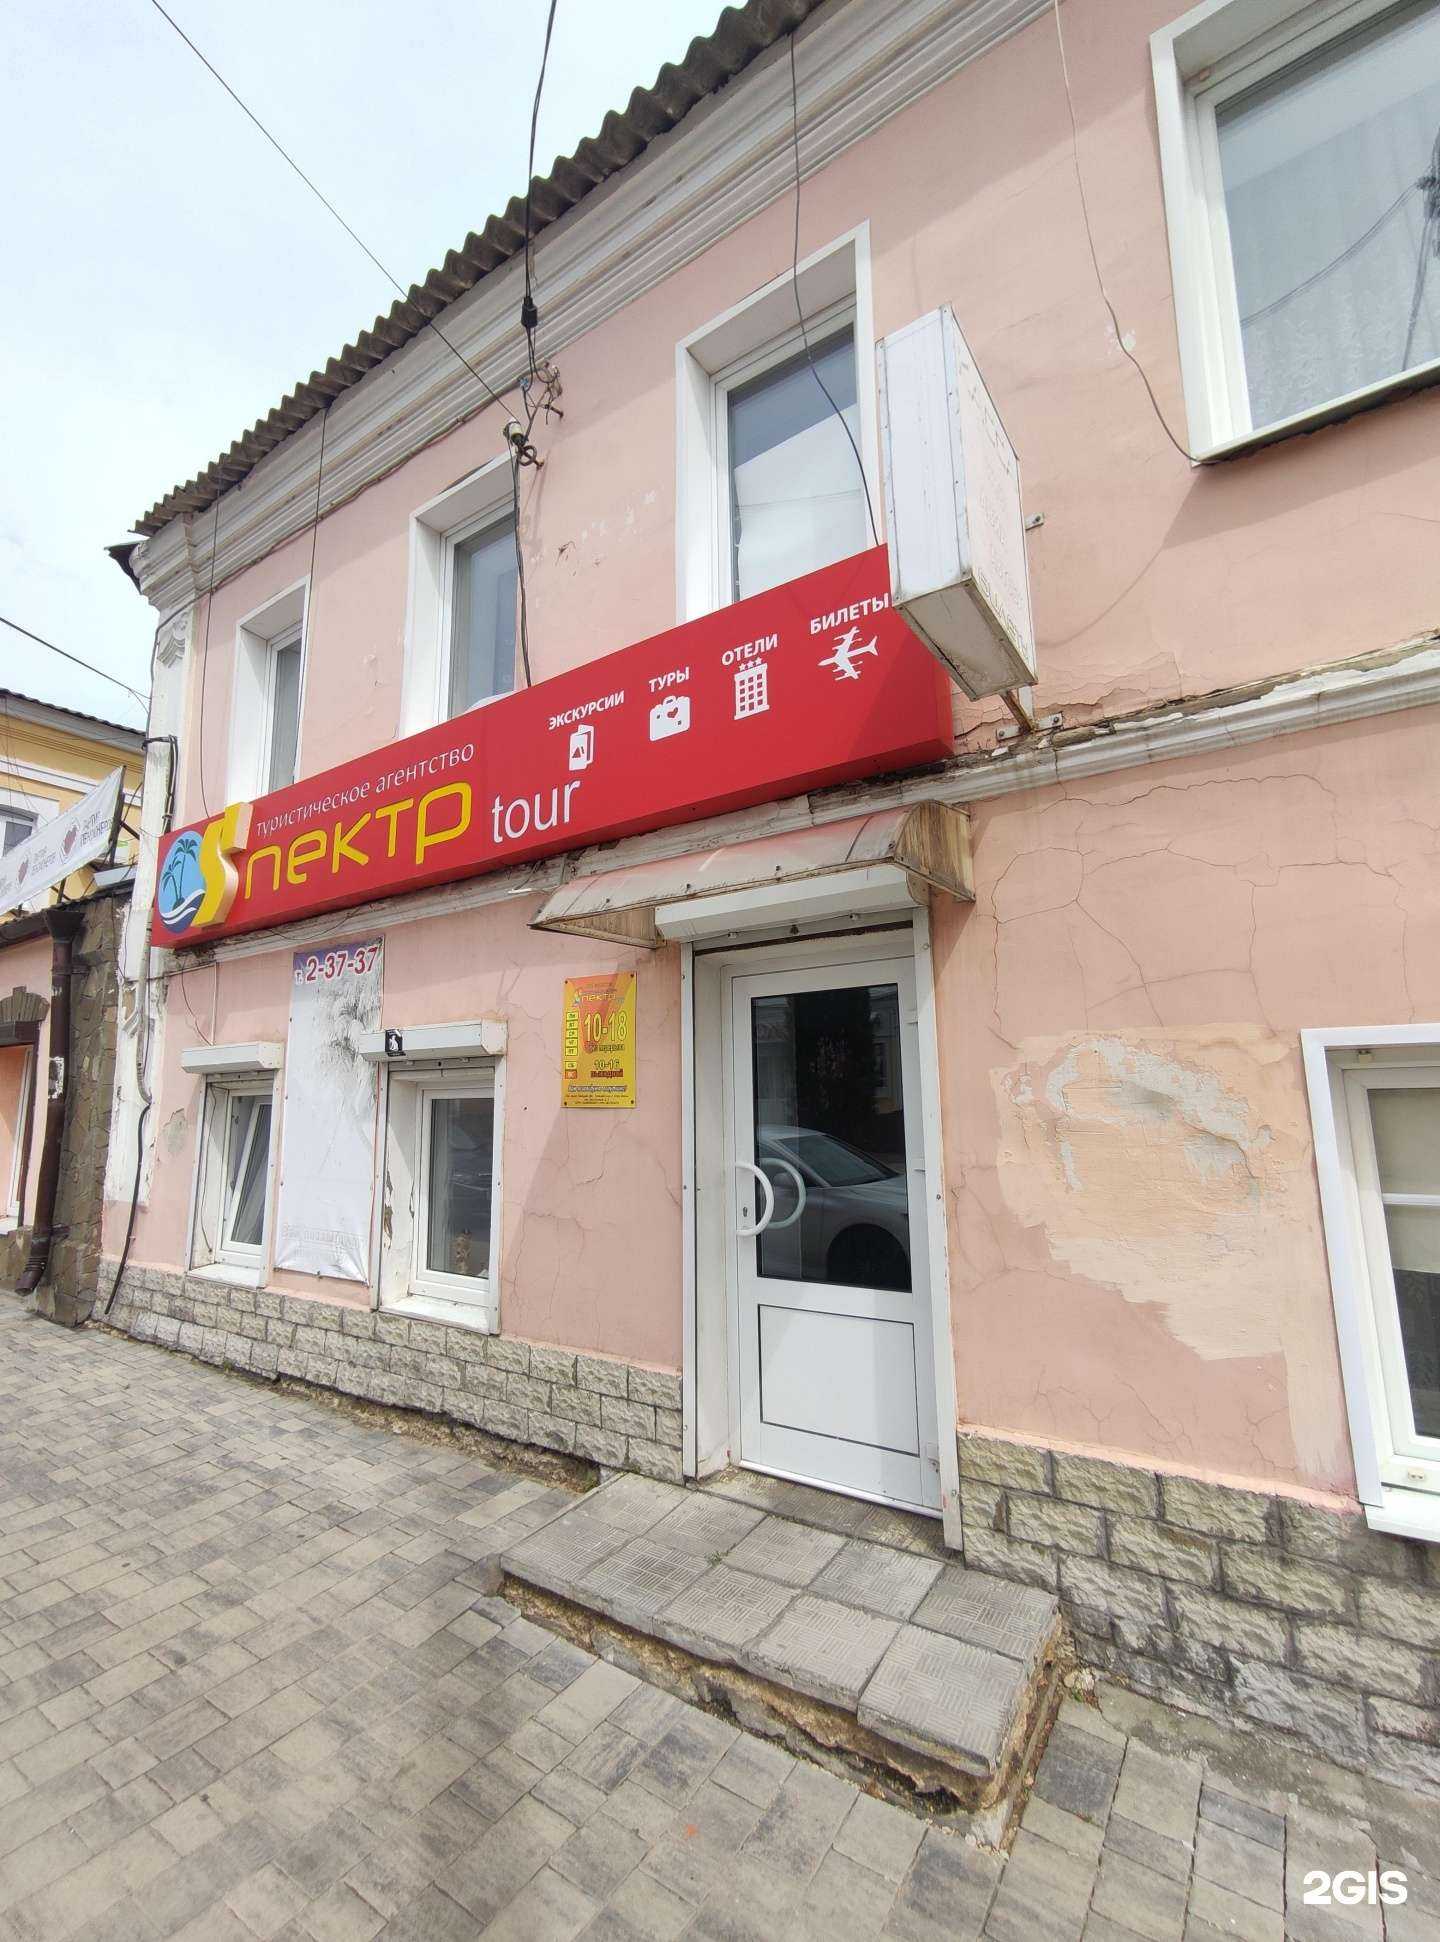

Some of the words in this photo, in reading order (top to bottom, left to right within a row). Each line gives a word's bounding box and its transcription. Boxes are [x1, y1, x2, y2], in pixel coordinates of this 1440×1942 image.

[810, 593, 889, 635] БИЛЕТЫ
[721, 634, 778, 666] ОТЕЛИ
[648, 666, 690, 693] ТУРЫ
[548, 690, 625, 730] ЭКСКУРСИИ
[256, 781, 370, 837] туристическое
[376, 743, 475, 794] агентство
[491, 780, 581, 843] tour
[306, 945, 379, 982] 2-37-37
[584, 1011, 627, 1042] 10-18
